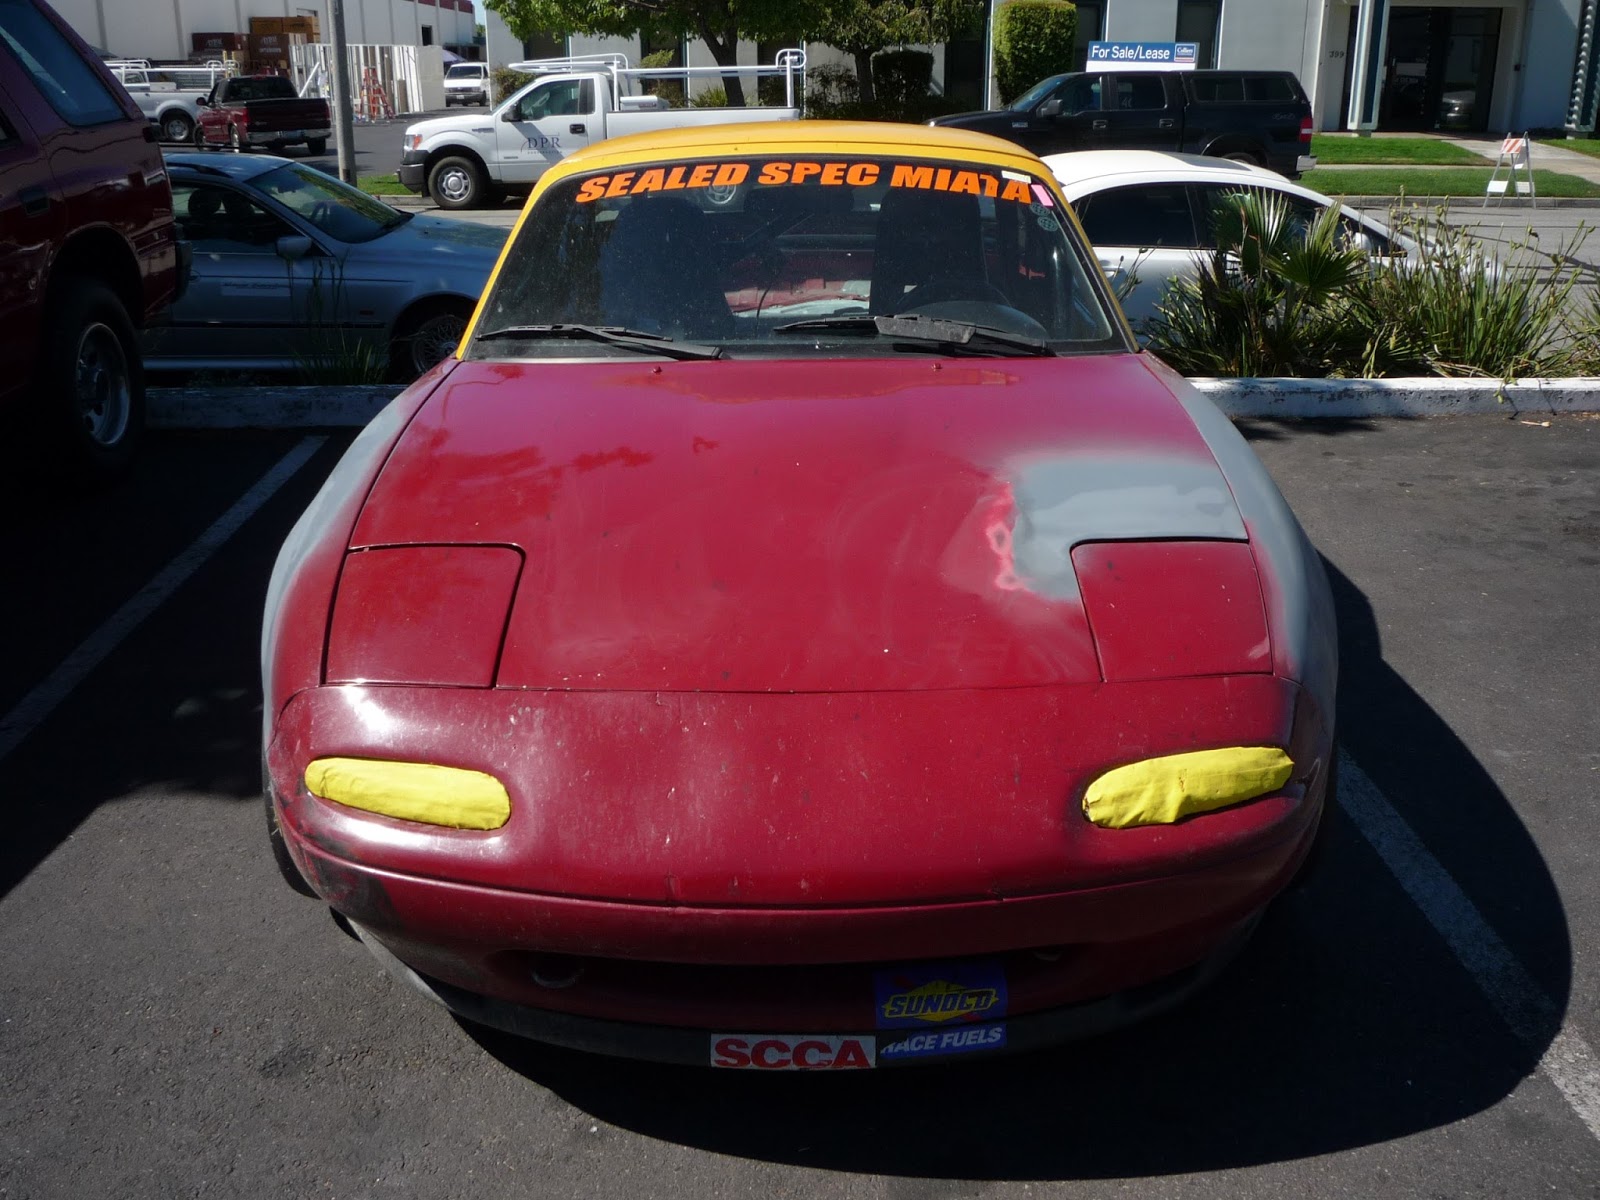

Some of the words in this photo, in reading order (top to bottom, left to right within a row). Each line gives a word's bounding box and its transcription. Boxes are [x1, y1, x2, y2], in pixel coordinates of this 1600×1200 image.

[1091, 45, 1110, 58] For
[1111, 45, 1171, 60] Sale/Lease
[527, 136, 561, 149] DPR
[576, 163, 750, 203] SEALED
[757, 162, 880, 186] SPEC
[890, 164, 1032, 204] MIATA
[886, 989, 995, 1018] SUNOCO
[940, 1026, 1003, 1049] FUELS
[713, 1039, 871, 1069] SCCA
